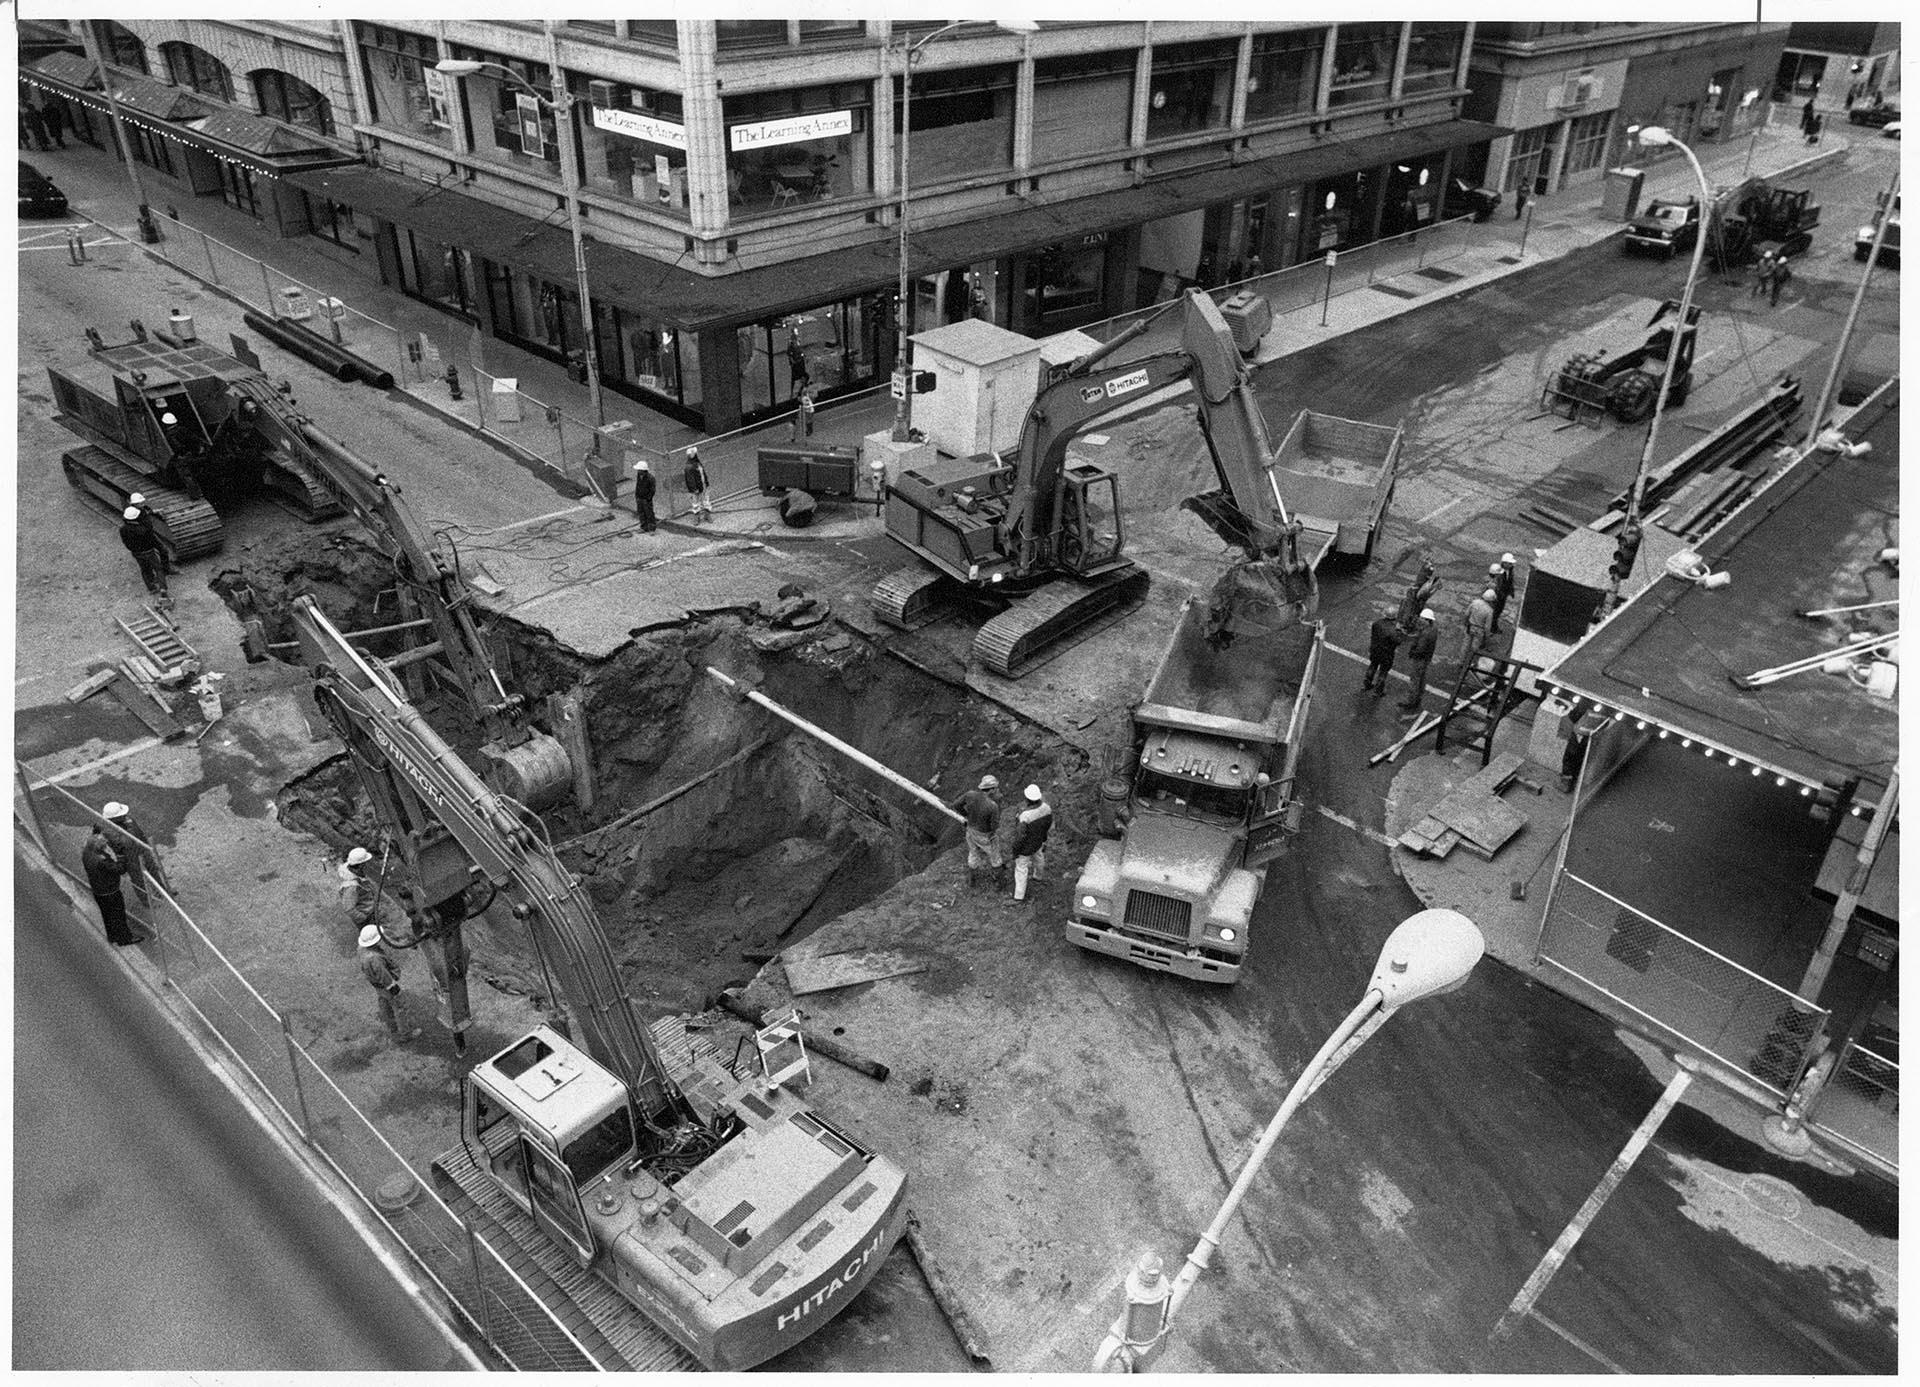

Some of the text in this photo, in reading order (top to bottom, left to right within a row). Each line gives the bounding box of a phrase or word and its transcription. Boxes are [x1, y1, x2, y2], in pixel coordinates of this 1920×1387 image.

[595, 107, 612, 122] The
[614, 112, 653, 137] Learning
[735, 118, 849, 144] The Learning Annex
[1116, 372, 1147, 391] HITACHI
[388, 741, 443, 806] HITACHI
[777, 1227, 884, 1331] HITACHI
